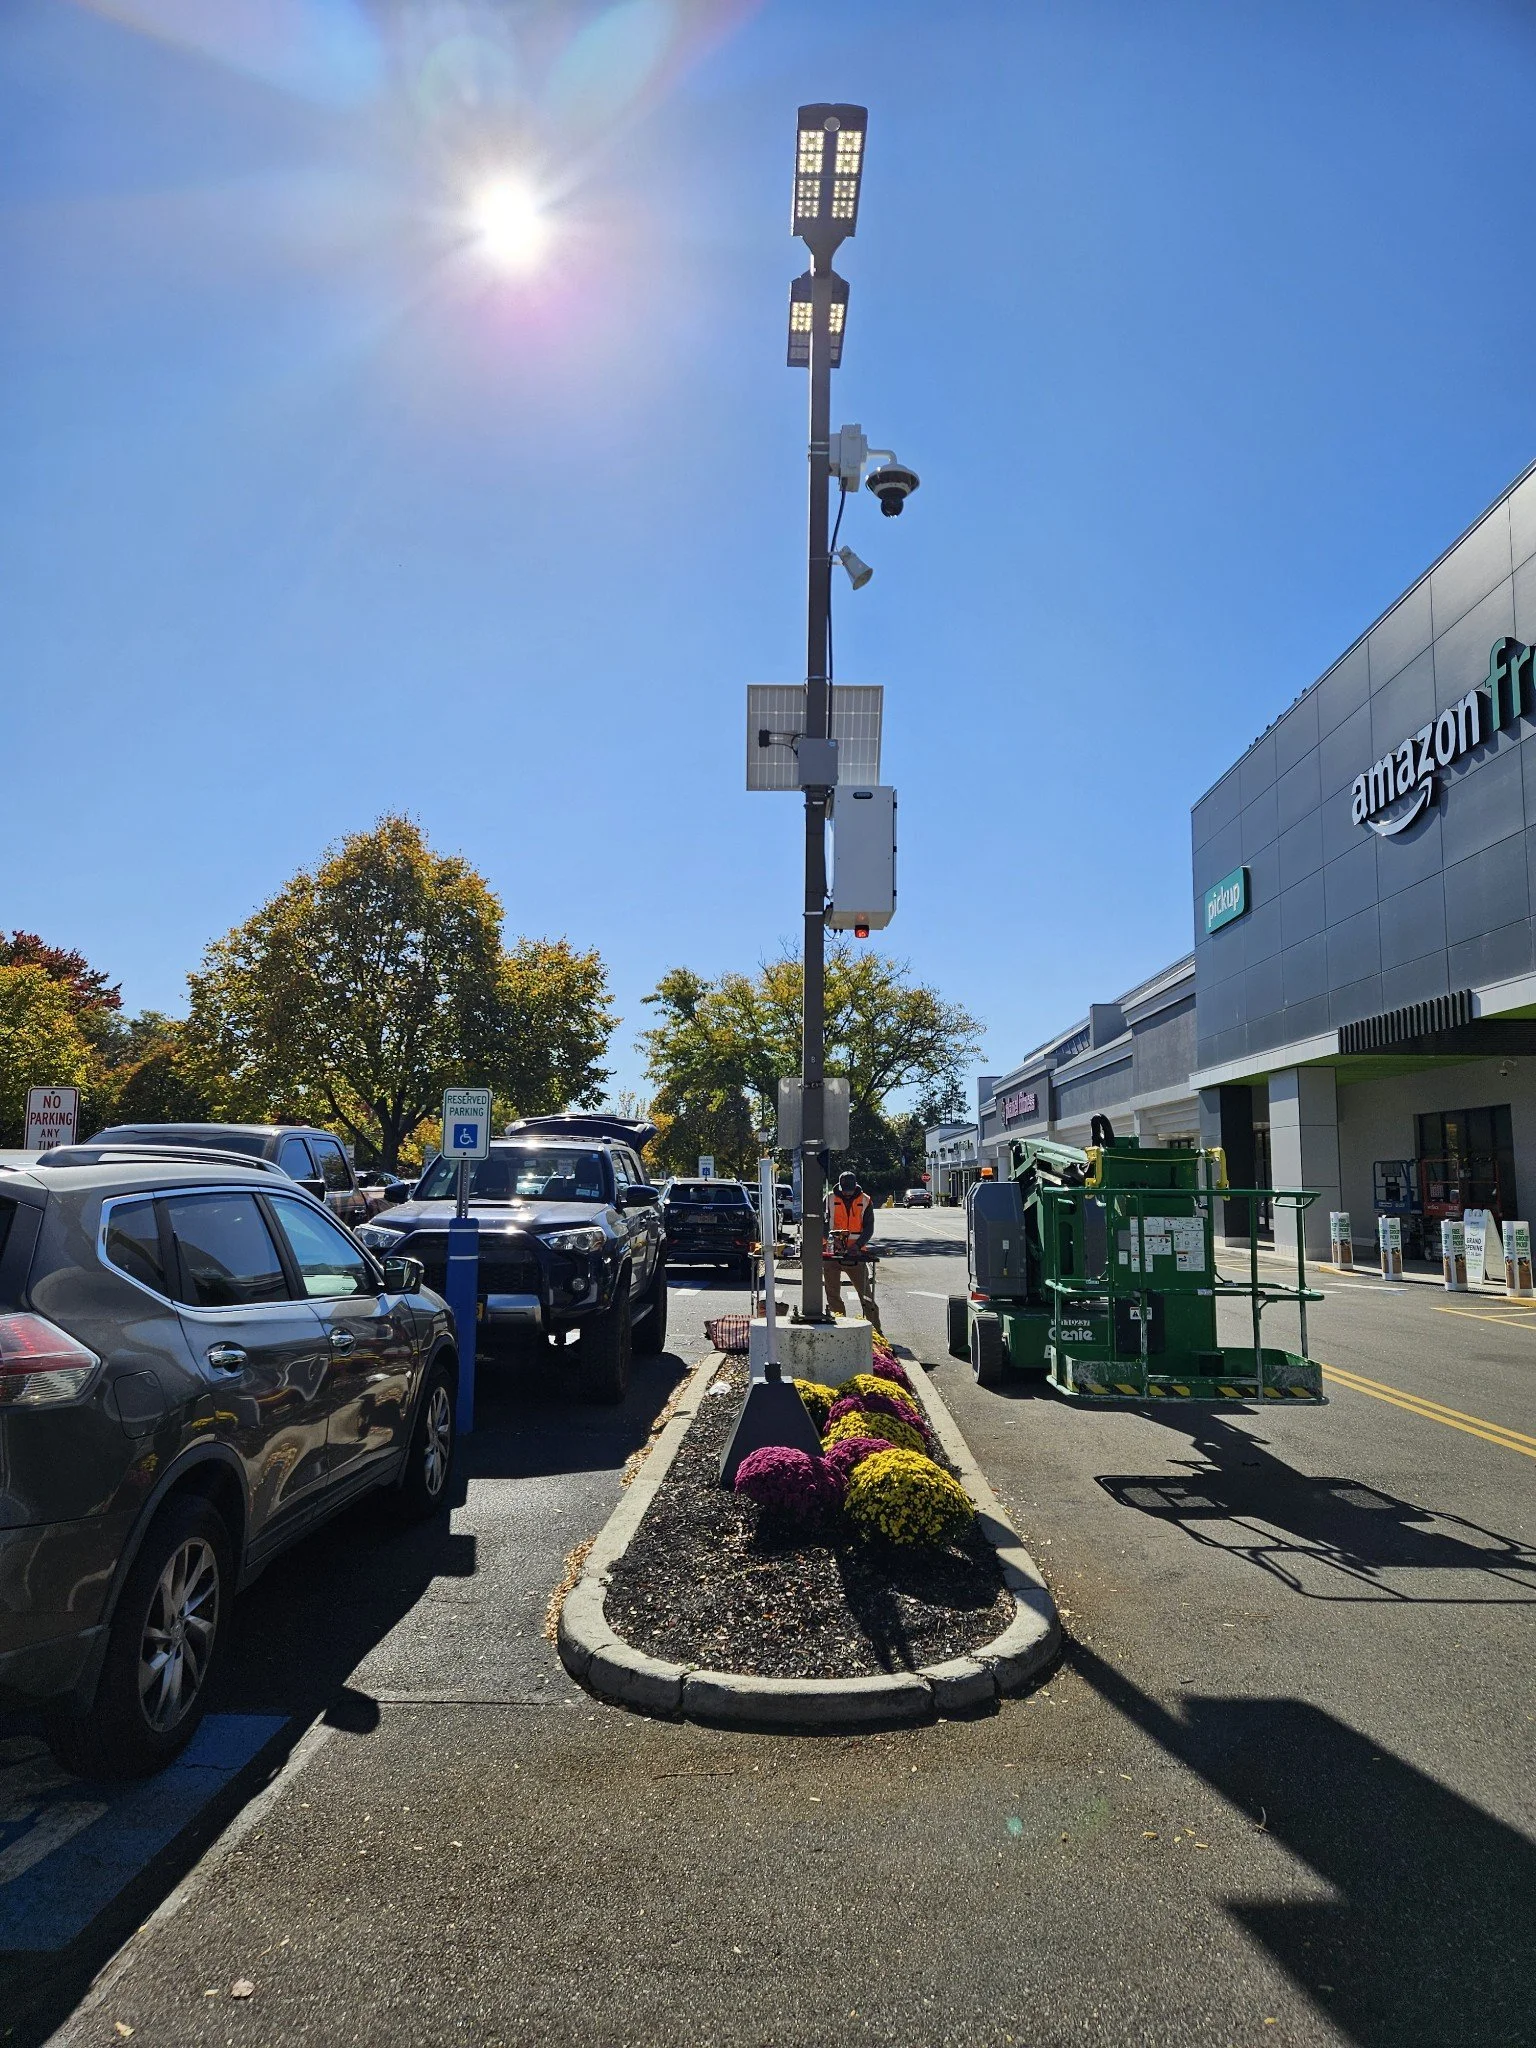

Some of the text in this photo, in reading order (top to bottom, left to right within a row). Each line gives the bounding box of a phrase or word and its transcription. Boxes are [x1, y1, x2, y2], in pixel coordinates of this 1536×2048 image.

[1351, 636, 1536, 826] amazon fr
[1208, 883, 1240, 928] pickup
[43, 1096, 61, 1109] NO
[447, 1095, 487, 1105] RESERVED
[1019, 1091, 1035, 1114] fitness
[450, 1107, 484, 1117] PARKING
[30, 1112, 73, 1126] PARKING
[40, 1128, 60, 1138] ANY
